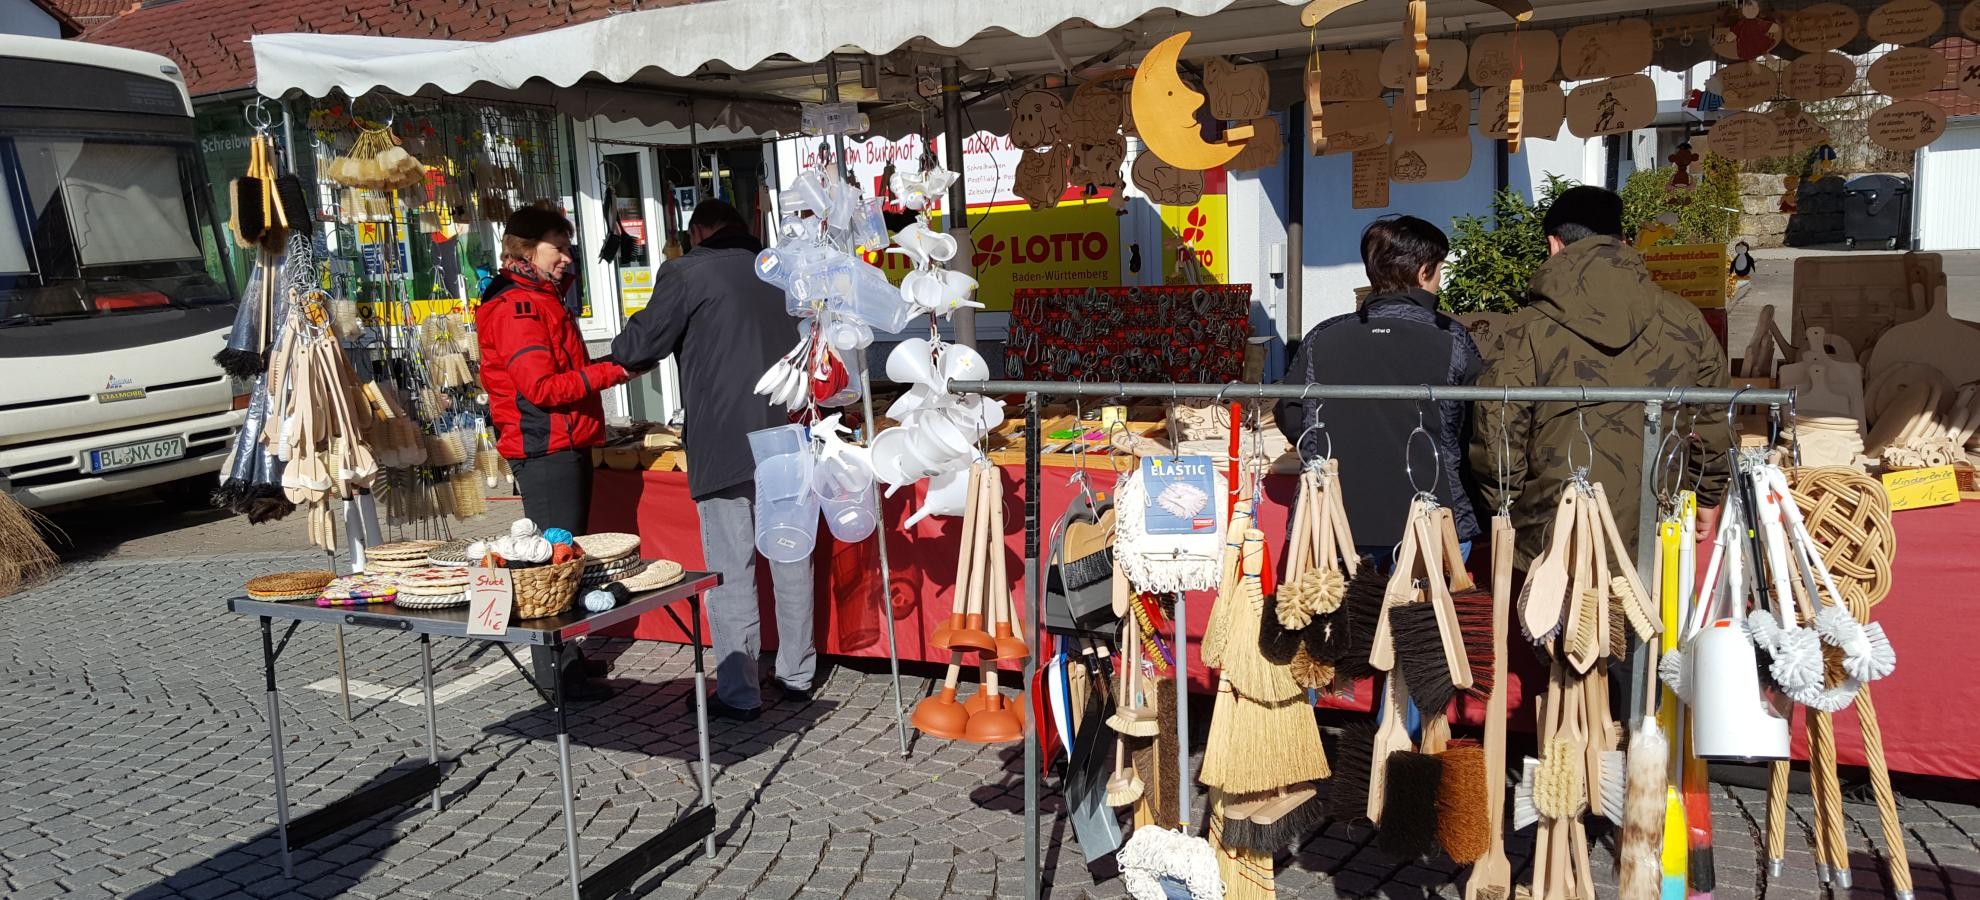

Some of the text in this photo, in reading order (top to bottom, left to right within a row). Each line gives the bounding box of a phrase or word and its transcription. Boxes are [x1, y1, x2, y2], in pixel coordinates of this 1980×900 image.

[202, 134, 250, 153] Schreibw
[802, 147, 837, 169] Lan
[865, 133, 914, 165] Burghof
[962, 130, 999, 155] aden
[1010, 231, 1108, 264] LOTTO
[1643, 250, 1720, 262] inderbrettchen
[1012, 269, 1109, 282] Baden-Württemberg
[101, 451, 123, 467] BL
[131, 444, 151, 461] NX
[154, 439, 180, 457] 697
[1151, 464, 1206, 476] ELASTIC
